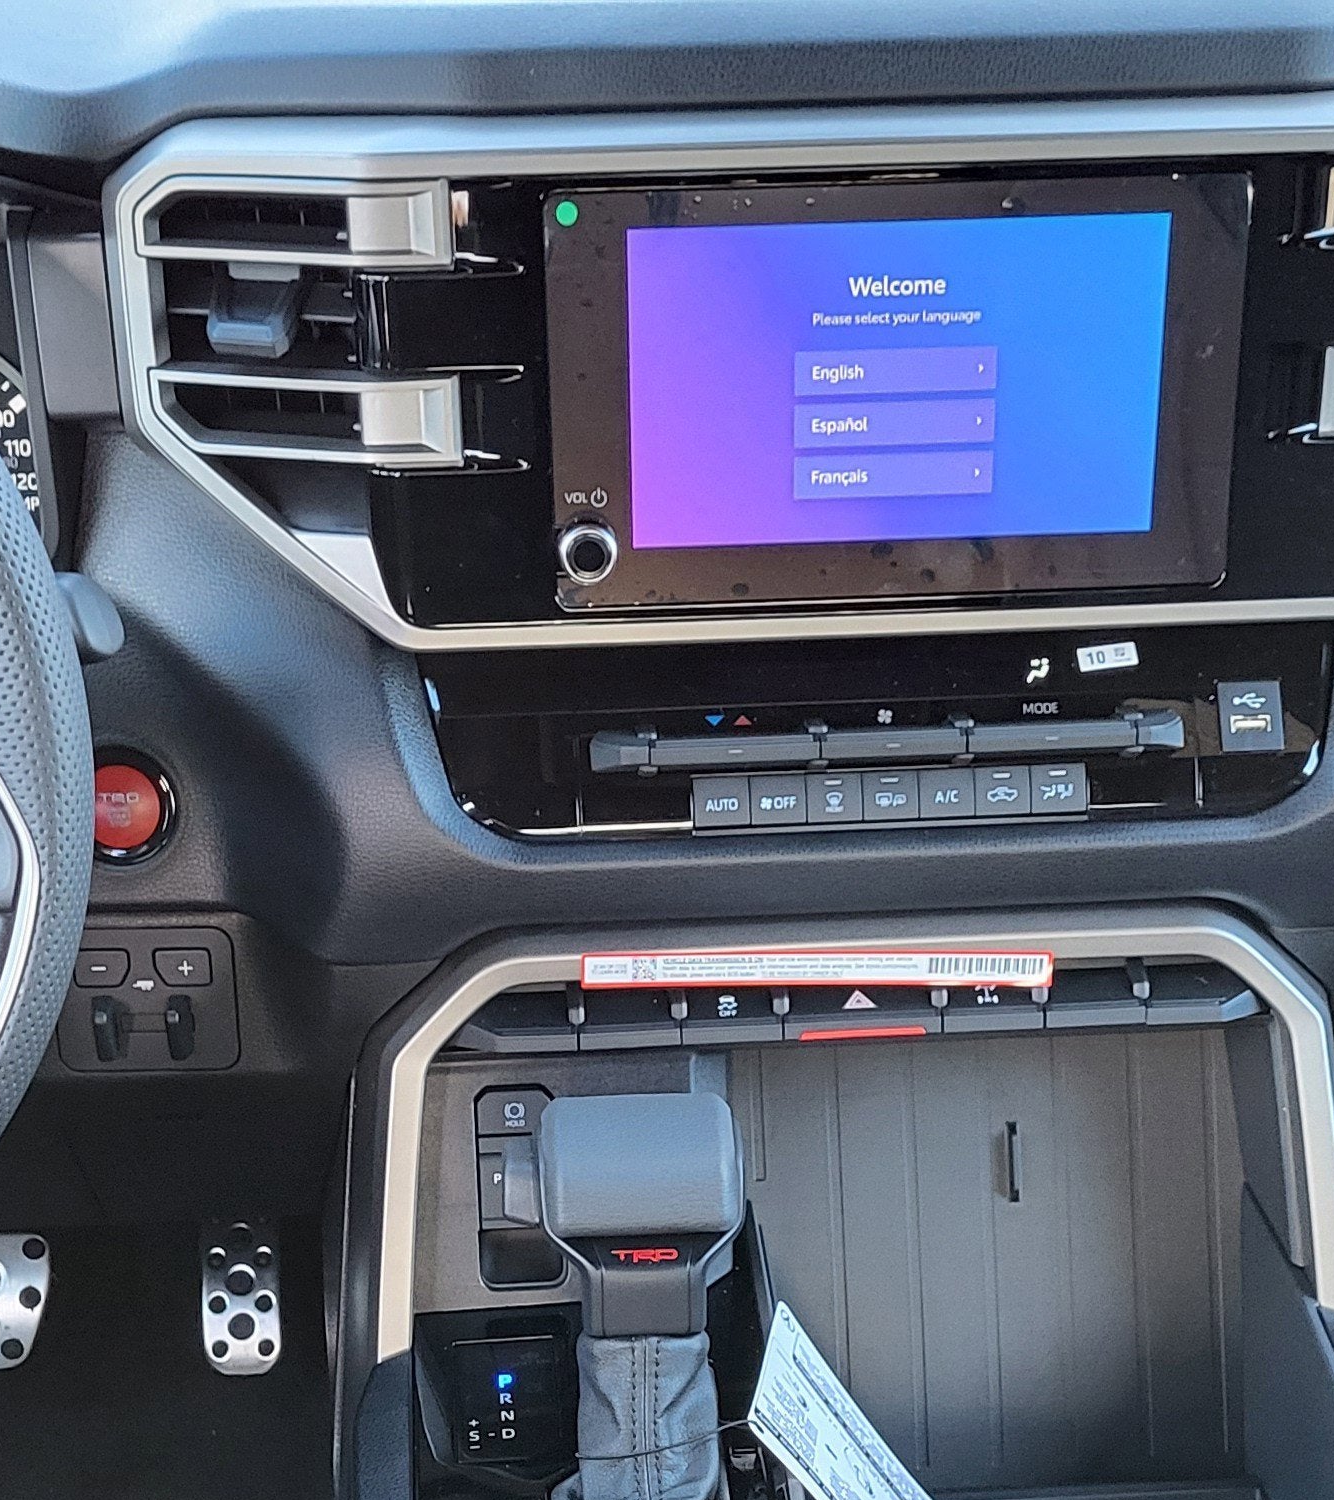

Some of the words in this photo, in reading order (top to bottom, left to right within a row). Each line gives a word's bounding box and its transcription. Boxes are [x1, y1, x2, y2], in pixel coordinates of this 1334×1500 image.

[848, 275, 947, 297] Welcome
[812, 312, 852, 327] Please
[855, 311, 890, 325] select
[892, 311, 920, 326] your
[922, 310, 982, 324] language
[812, 364, 864, 383] English
[811, 416, 868, 436] Español
[3, 438, 32, 458] 110
[811, 469, 868, 487] Français
[564, 492, 588, 504] VOL
[1087, 651, 1106, 665] 10
[1022, 702, 1060, 715] MODE
[773, 796, 797, 810] OFF
[934, 789, 960, 804] A/C
[705, 797, 739, 812] AUTO
[505, 1119, 525, 1128] HOLD
[493, 1173, 502, 1185] P
[611, 1247, 679, 1264] TRD
[498, 1374, 513, 1389] P
[499, 1392, 514, 1405] R
[500, 1409, 515, 1422] N
[468, 1430, 480, 1442] S
[501, 1428, 516, 1440] D
